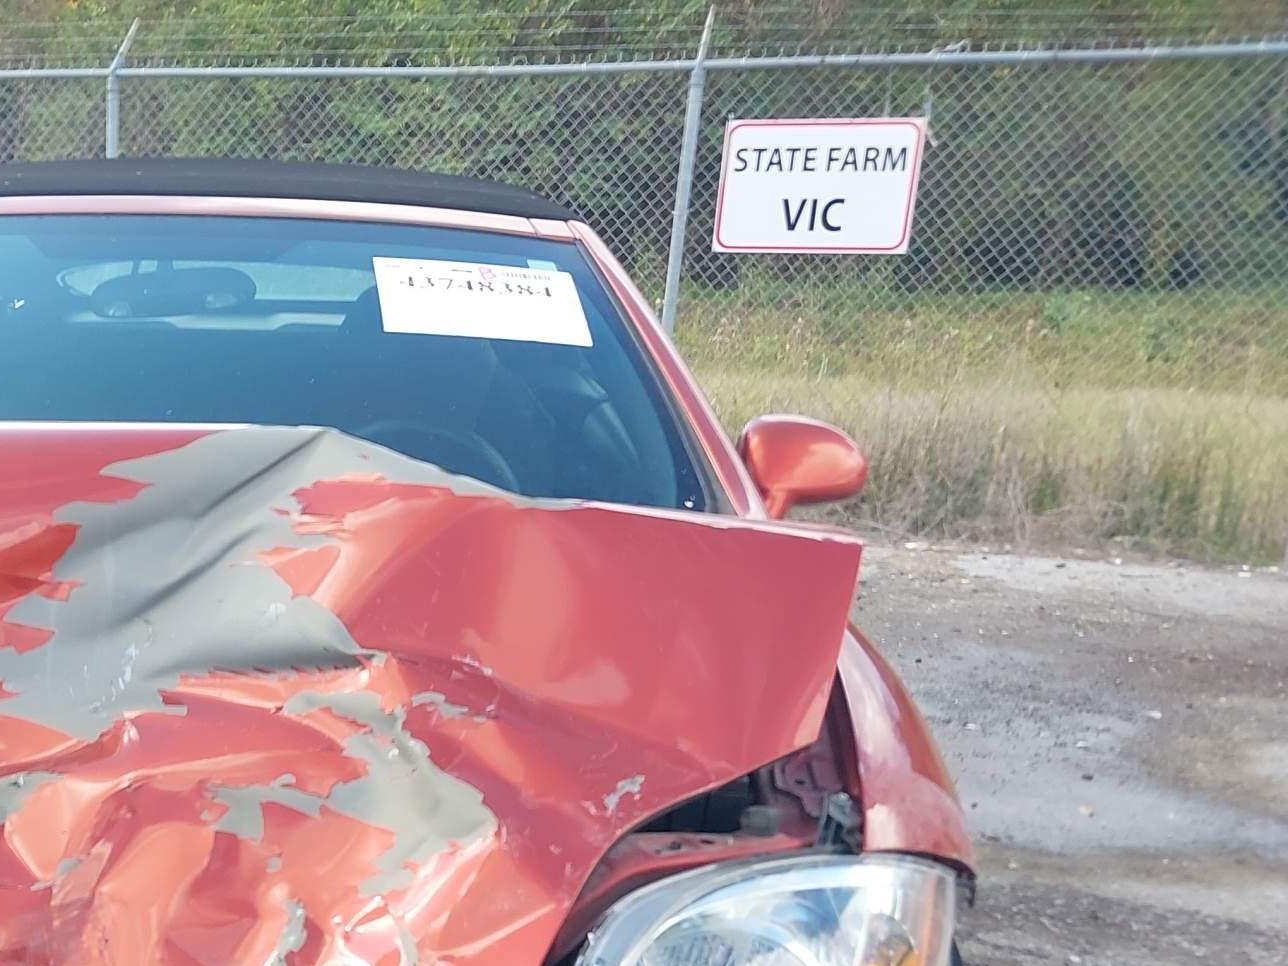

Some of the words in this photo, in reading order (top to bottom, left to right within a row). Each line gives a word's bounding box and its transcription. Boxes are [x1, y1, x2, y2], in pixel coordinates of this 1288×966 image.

[734, 148, 818, 172] STATE
[826, 147, 908, 172] FARM
[782, 198, 846, 231] VIC
